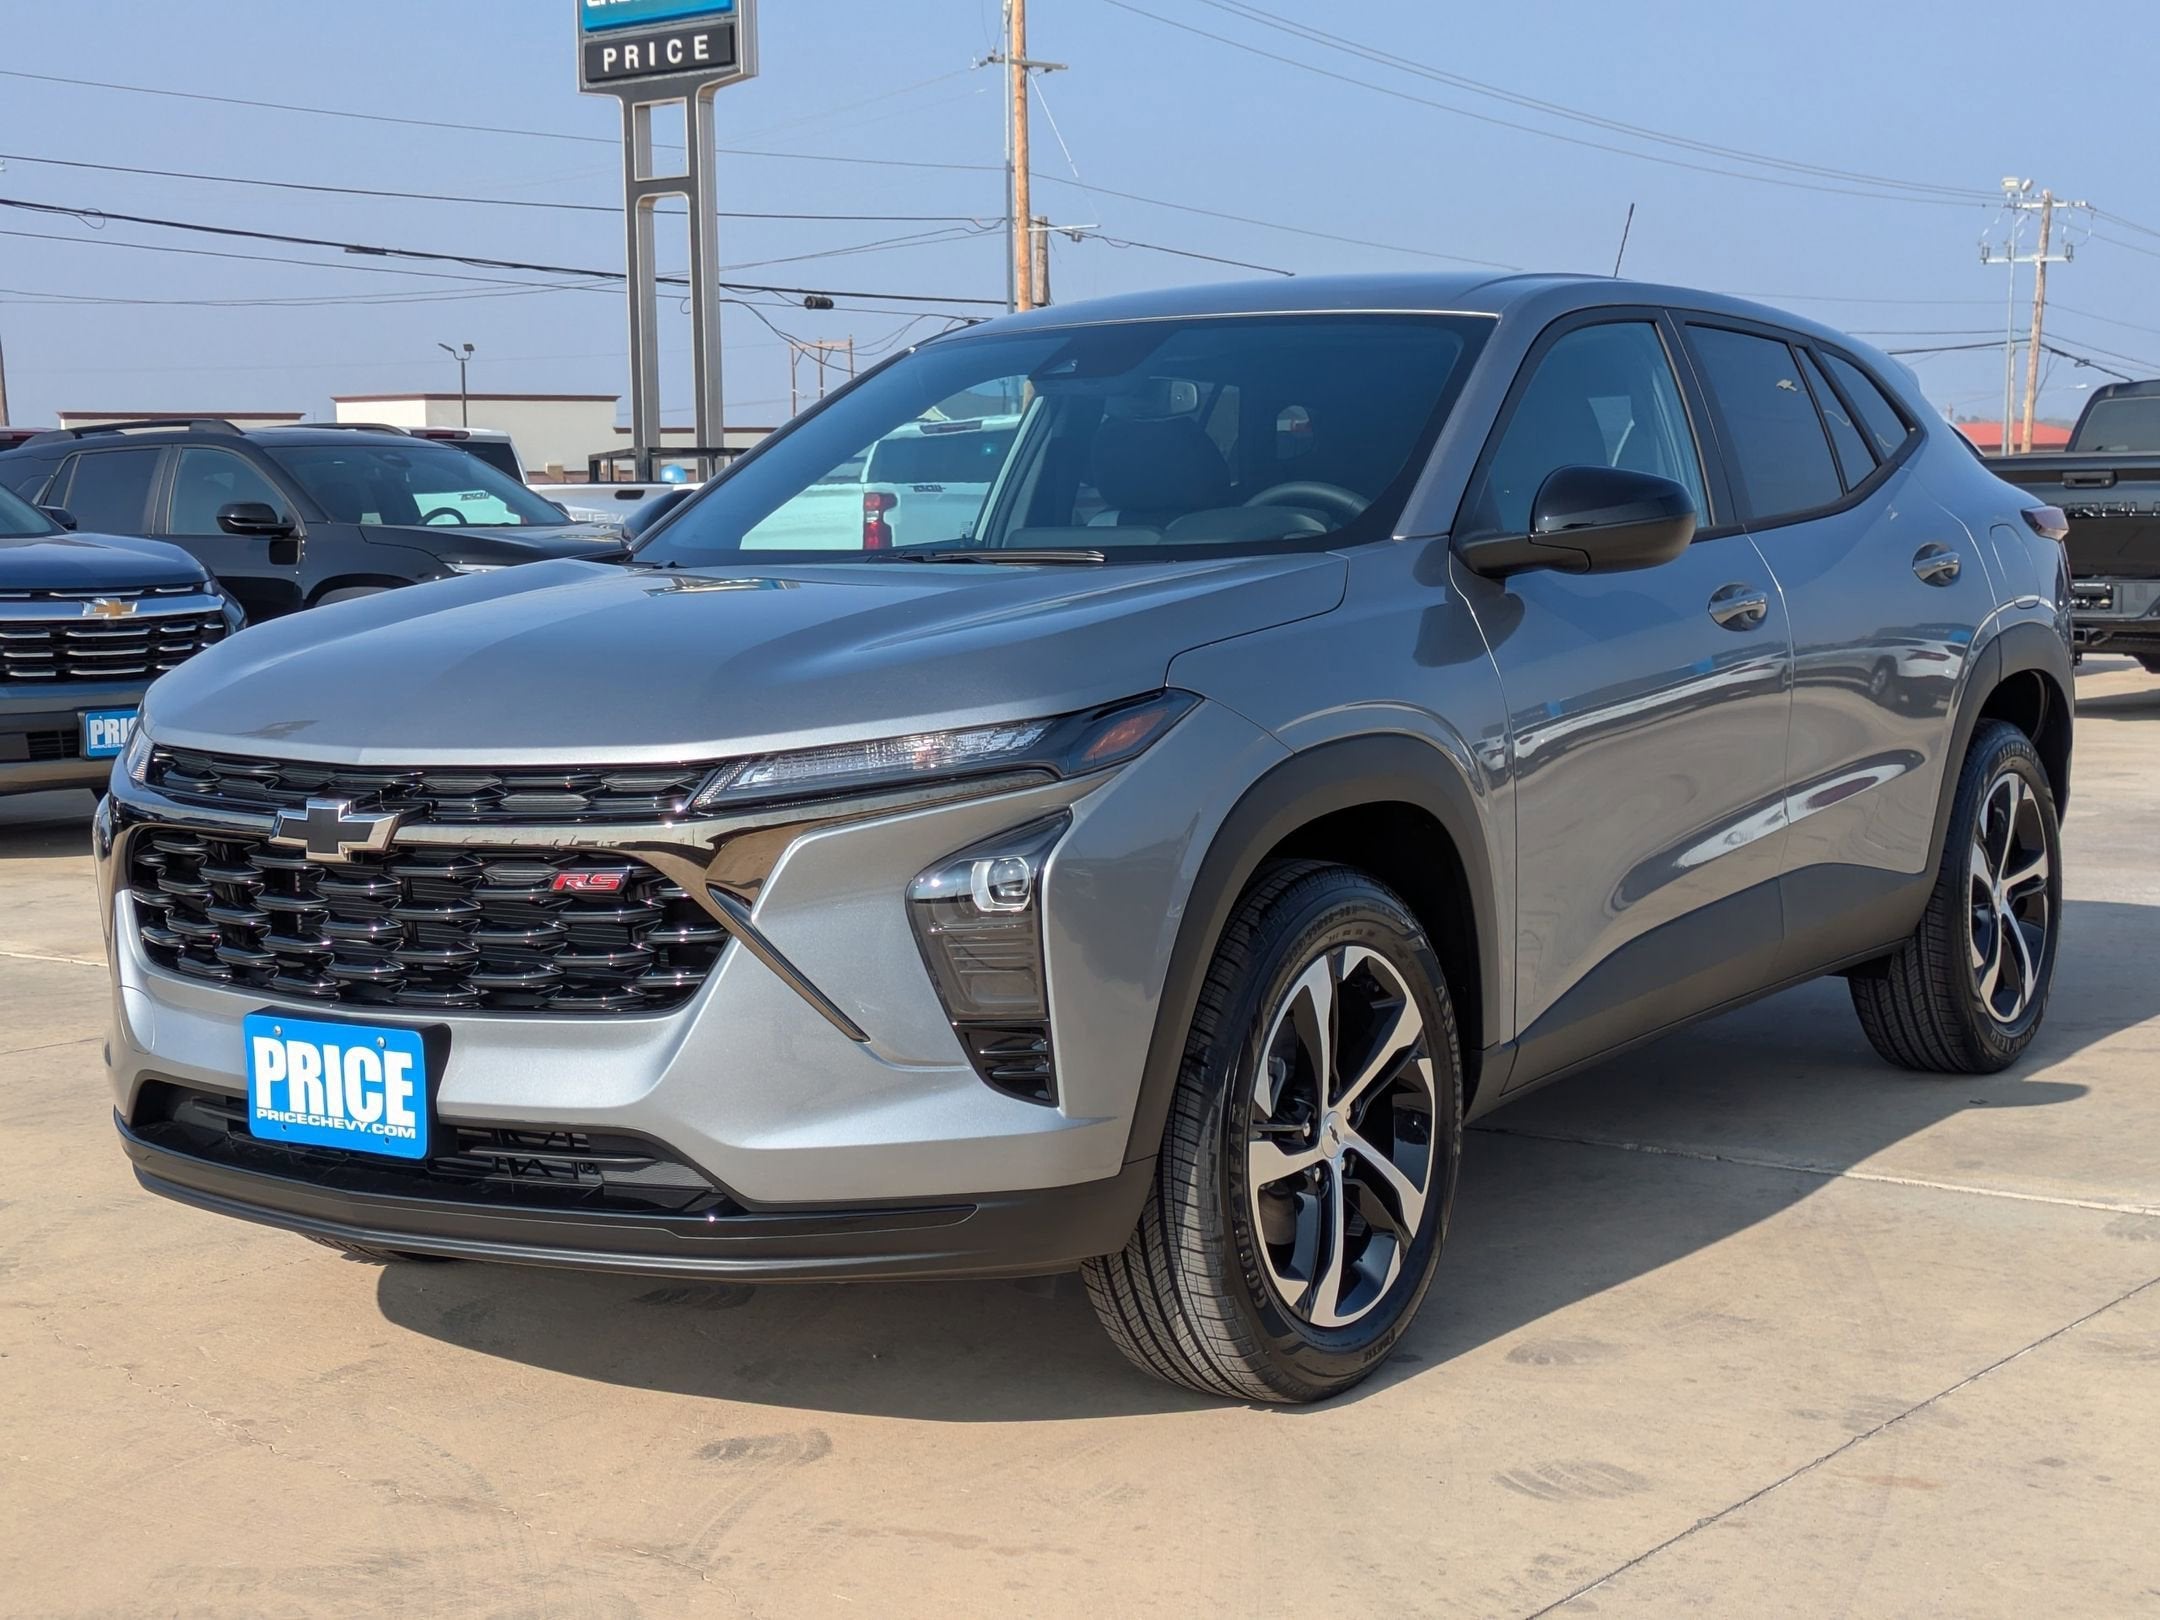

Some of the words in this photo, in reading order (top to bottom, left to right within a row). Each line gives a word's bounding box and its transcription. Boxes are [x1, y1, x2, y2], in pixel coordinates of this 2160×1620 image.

[603, 34, 709, 72] PRICE
[552, 872, 623, 891] RS
[252, 1036, 416, 1127] PRICE
[256, 1108, 416, 1139] PRICECHEVY.COM
[1229, 1102, 1268, 1309] GOODYEAR
